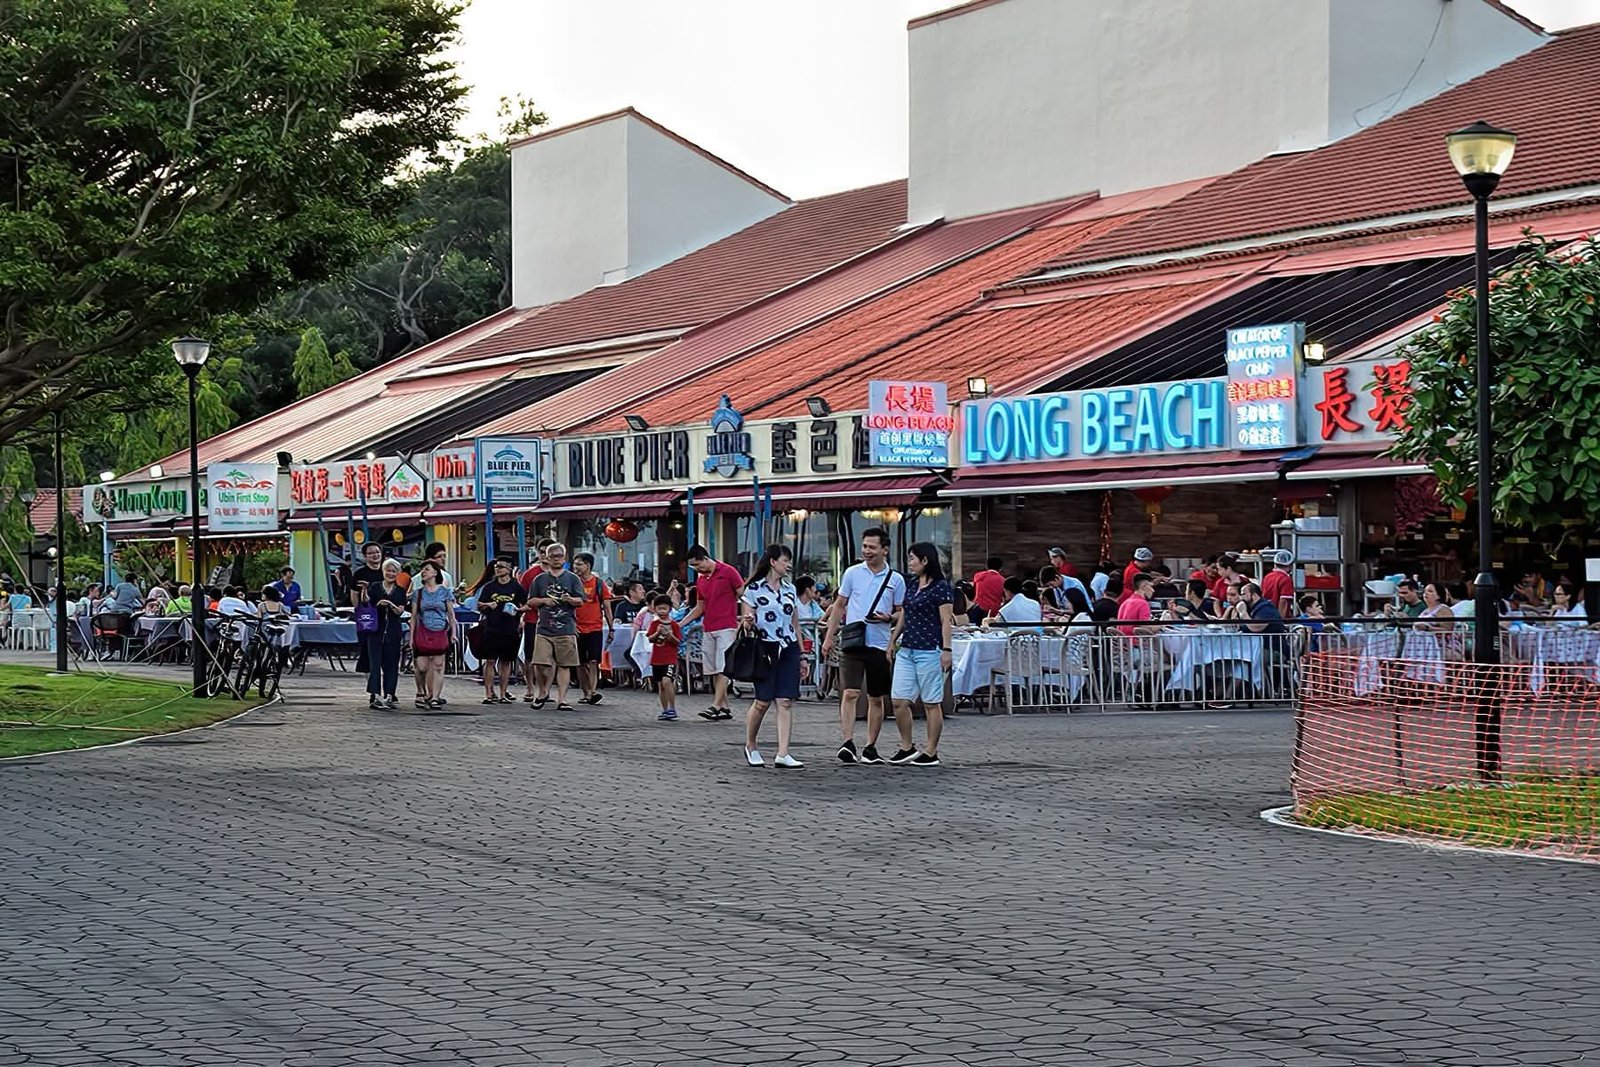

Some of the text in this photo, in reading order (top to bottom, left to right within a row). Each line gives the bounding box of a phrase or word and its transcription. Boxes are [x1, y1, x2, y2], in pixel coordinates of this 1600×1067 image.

[866, 415, 955, 431] LONG BEACH
[966, 380, 1226, 464] LONG BEACH
[434, 454, 467, 479] Ubin
[487, 461, 531, 470] BLUE PIER
[569, 430, 690, 488] BLUE PIER
[218, 492, 235, 503] Ubin
[236, 492, 251, 503] First
[253, 491, 270, 506] Stop
